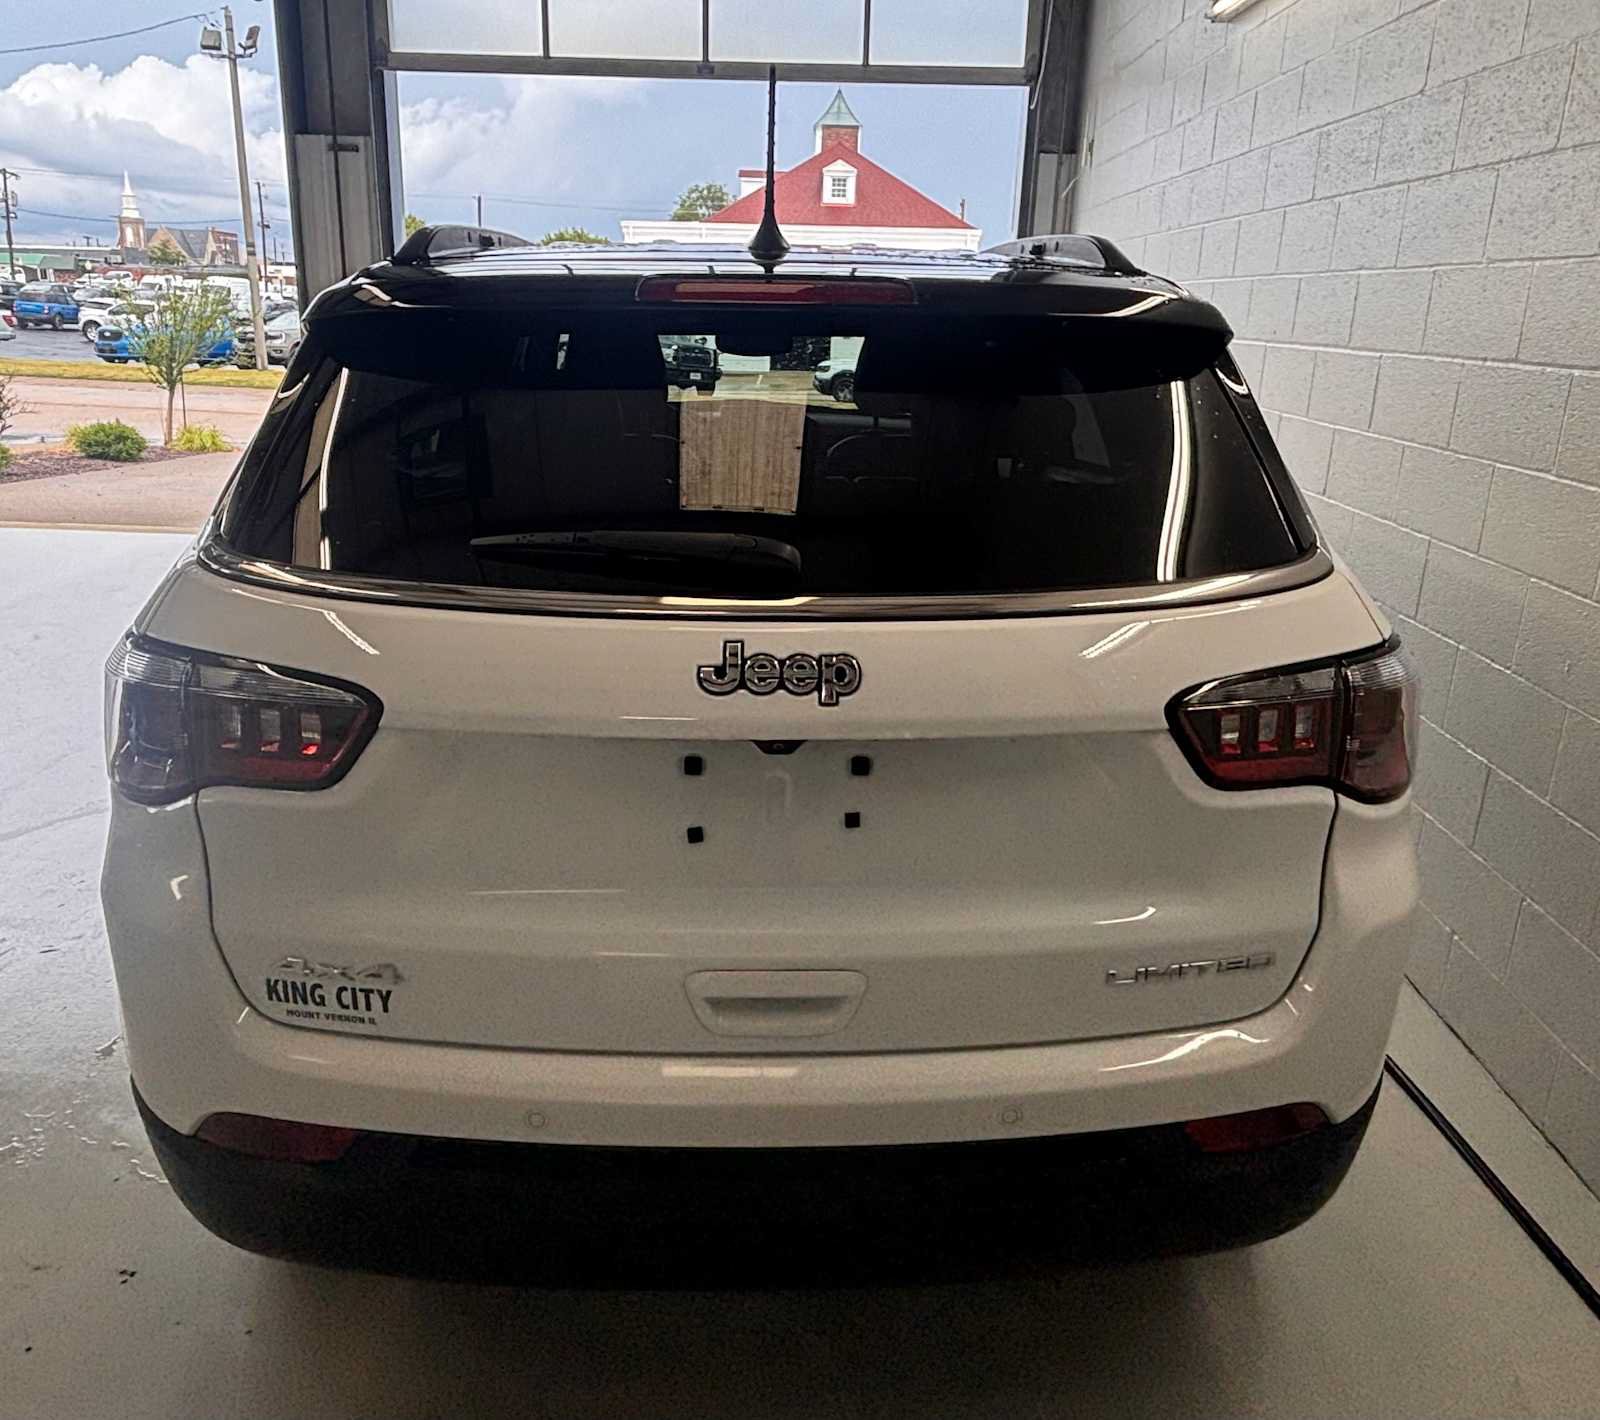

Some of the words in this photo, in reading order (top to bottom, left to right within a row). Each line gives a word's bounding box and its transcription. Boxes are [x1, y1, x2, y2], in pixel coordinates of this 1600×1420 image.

[697, 639, 862, 707] Jeep
[1107, 953, 1275, 984] LIMITED
[266, 977, 326, 1007] KING
[335, 986, 392, 1013] CITY
[286, 1008, 321, 1019] MOUNT
[324, 1013, 365, 1024] VERNON
